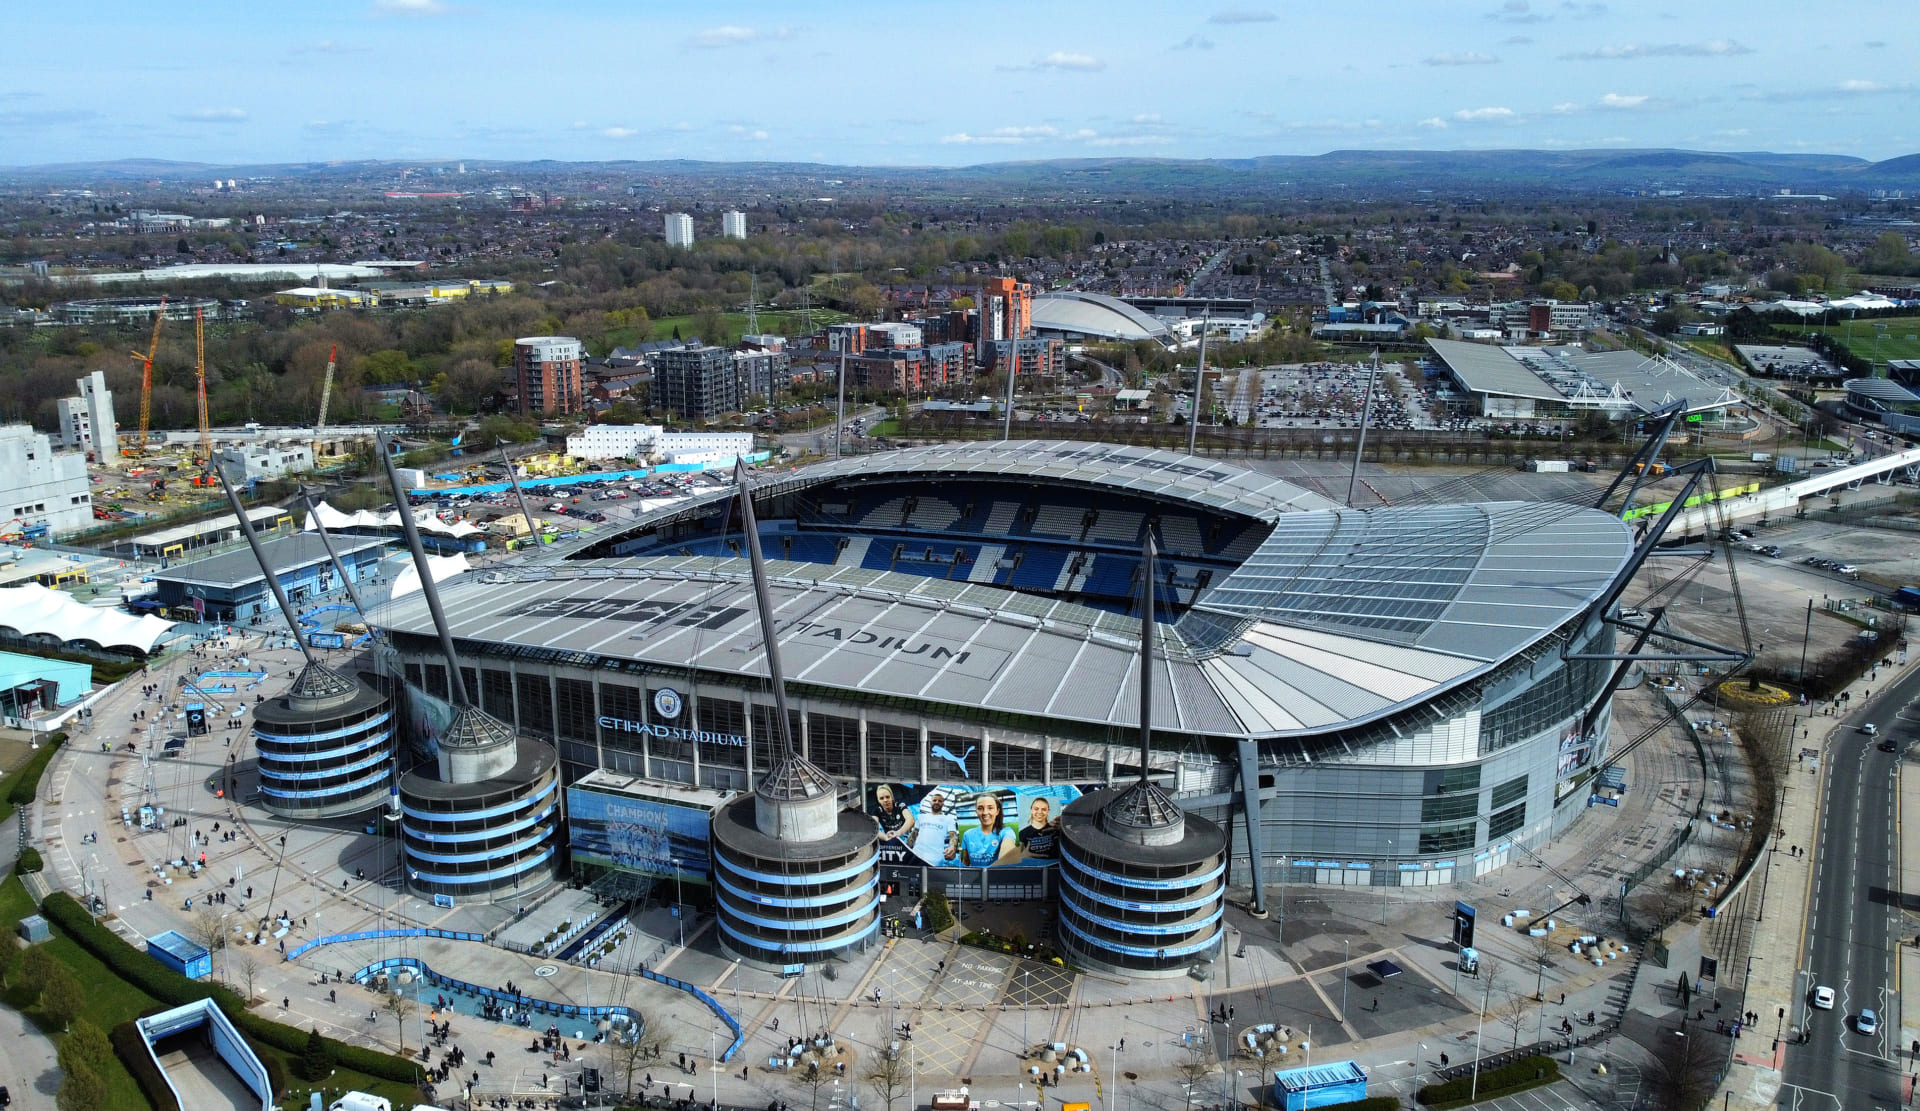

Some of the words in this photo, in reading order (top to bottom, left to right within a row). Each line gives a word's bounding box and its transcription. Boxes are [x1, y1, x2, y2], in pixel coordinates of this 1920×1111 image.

[774, 618, 971, 665] TADIUM
[599, 716, 670, 737] ETIHAD
[673, 728, 743, 747] STADIUM
[606, 803, 668, 827] CHAMPIONS
